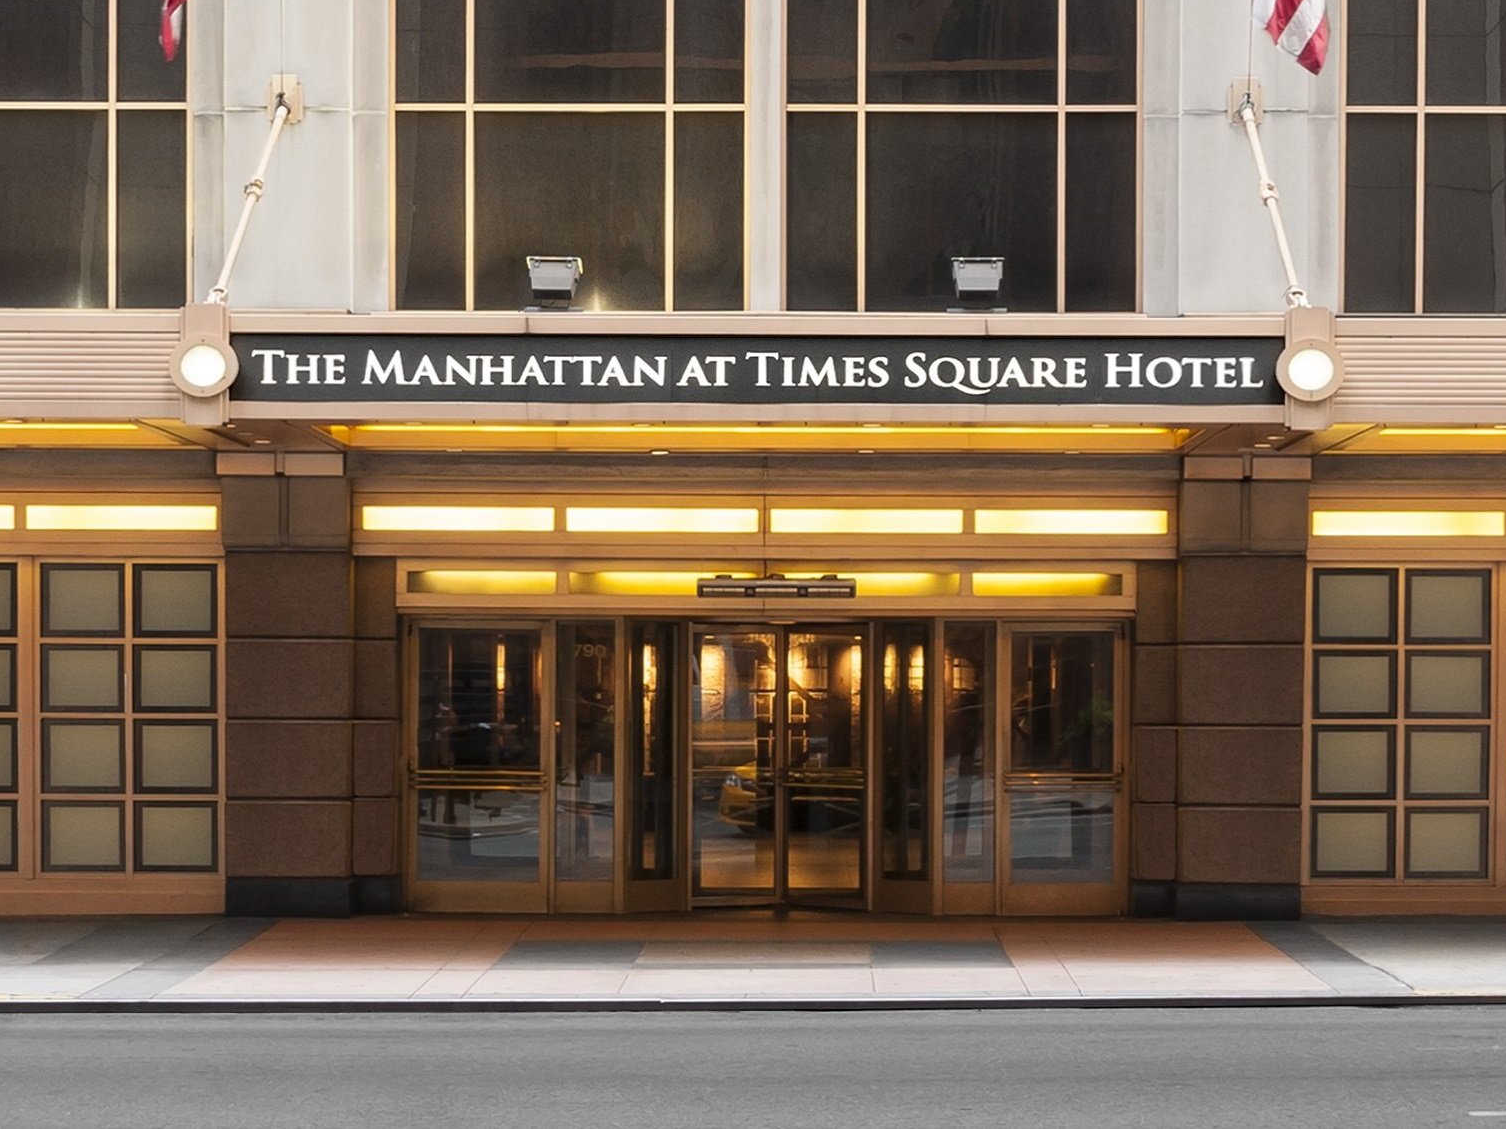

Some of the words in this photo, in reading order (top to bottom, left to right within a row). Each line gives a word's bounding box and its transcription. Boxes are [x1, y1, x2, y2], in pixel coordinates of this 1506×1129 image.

[251, 349, 346, 385] THE
[361, 349, 668, 387] MANHATTAN
[675, 355, 737, 387] AT
[744, 351, 890, 388] TIMES
[904, 351, 1088, 396] SQUARE
[1103, 352, 1264, 389] HOTEL
[573, 643, 607, 658] 790
